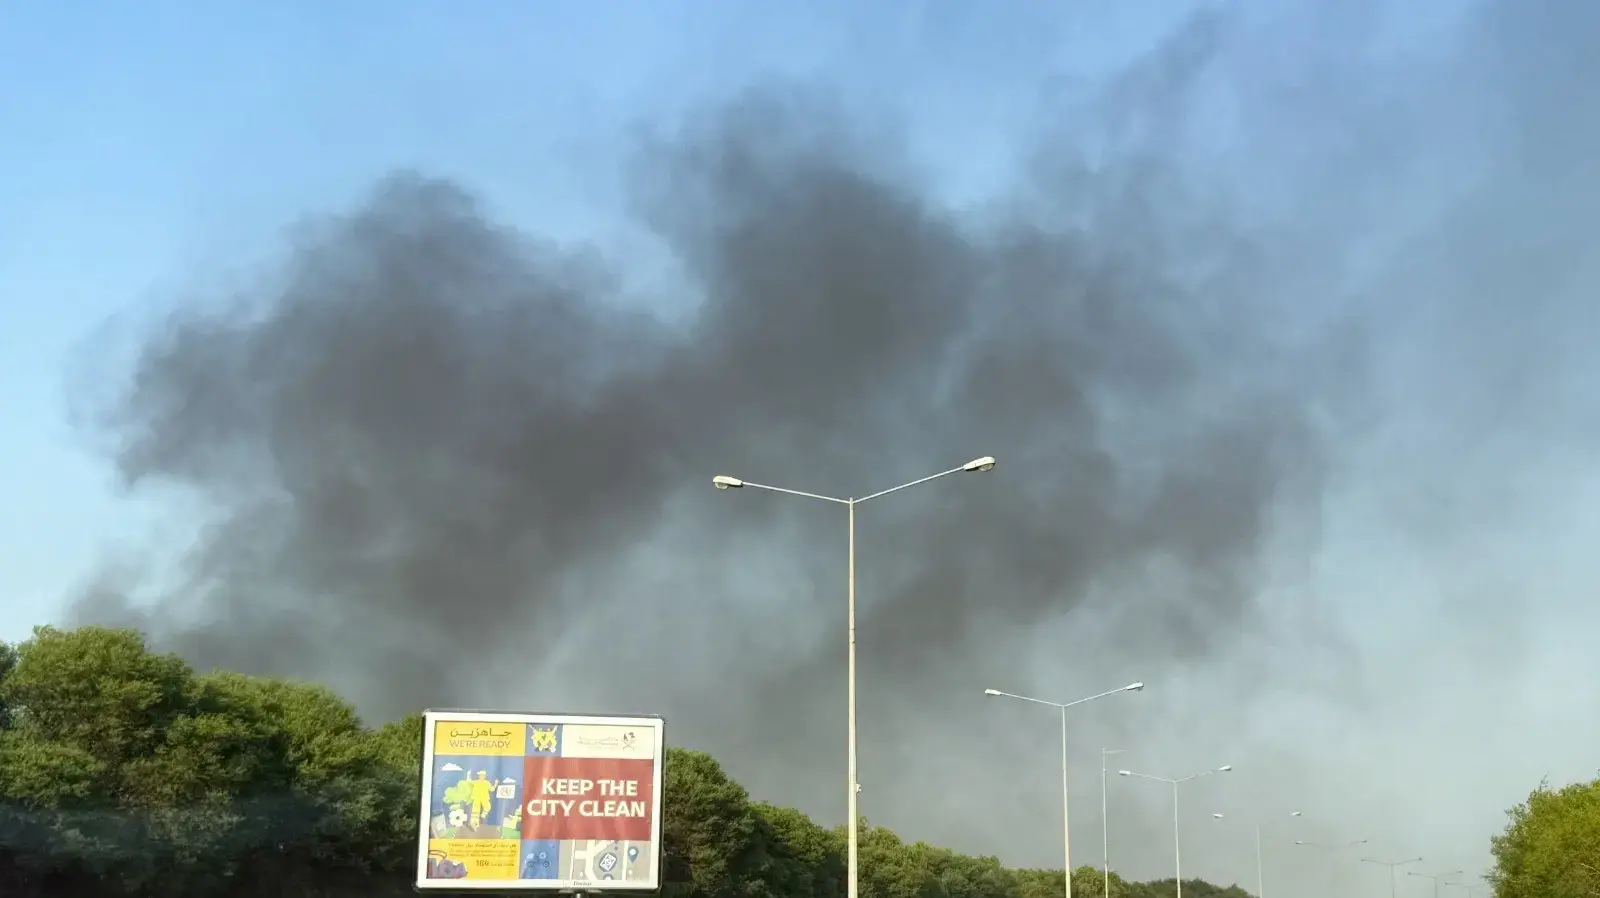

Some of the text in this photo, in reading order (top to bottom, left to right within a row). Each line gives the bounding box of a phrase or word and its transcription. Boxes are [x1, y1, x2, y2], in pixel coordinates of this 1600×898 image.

[450, 728, 511, 739] جاهزين
[479, 740, 511, 748] READY
[541, 778, 638, 796] KEEP THE
[527, 799, 645, 817] CITY CLEAN
